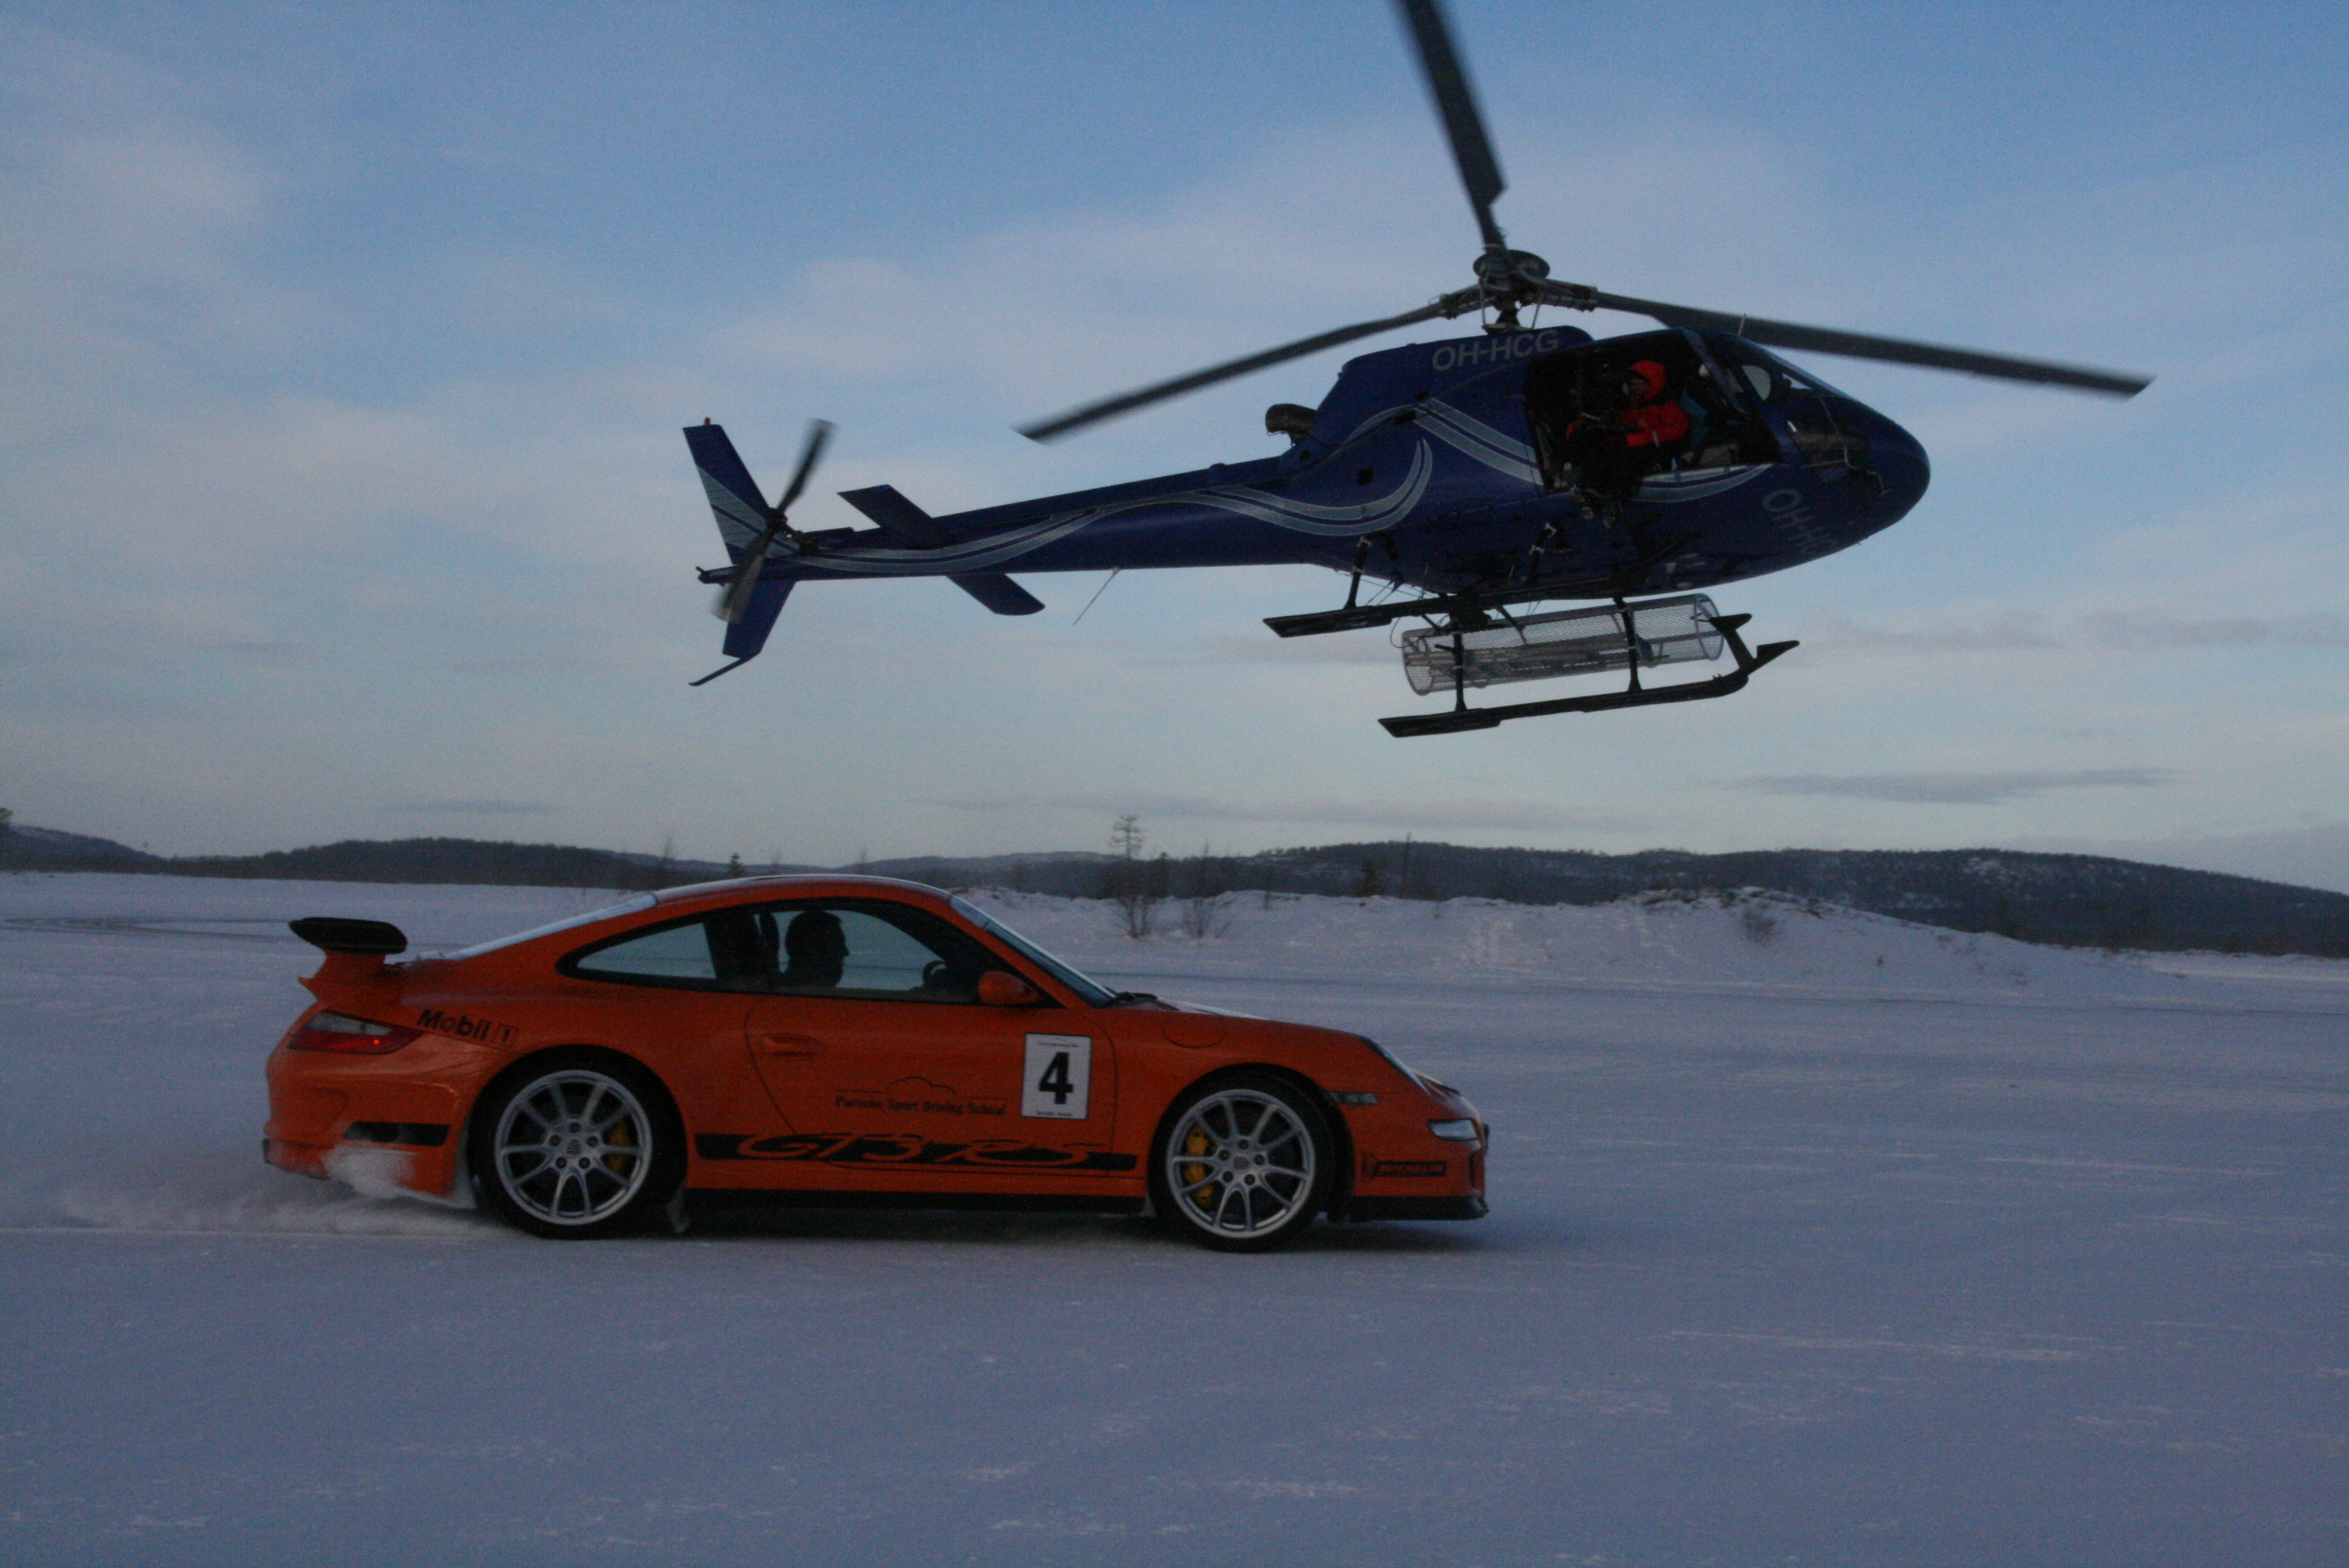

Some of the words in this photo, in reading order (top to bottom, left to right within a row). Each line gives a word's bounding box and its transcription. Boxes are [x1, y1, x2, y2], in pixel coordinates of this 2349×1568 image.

[1431, 329, 1560, 372] OH-HCG
[416, 1008, 491, 1041] Mobil
[1038, 1052, 1074, 1105] 4
[888, 1098, 918, 1112] Sport
